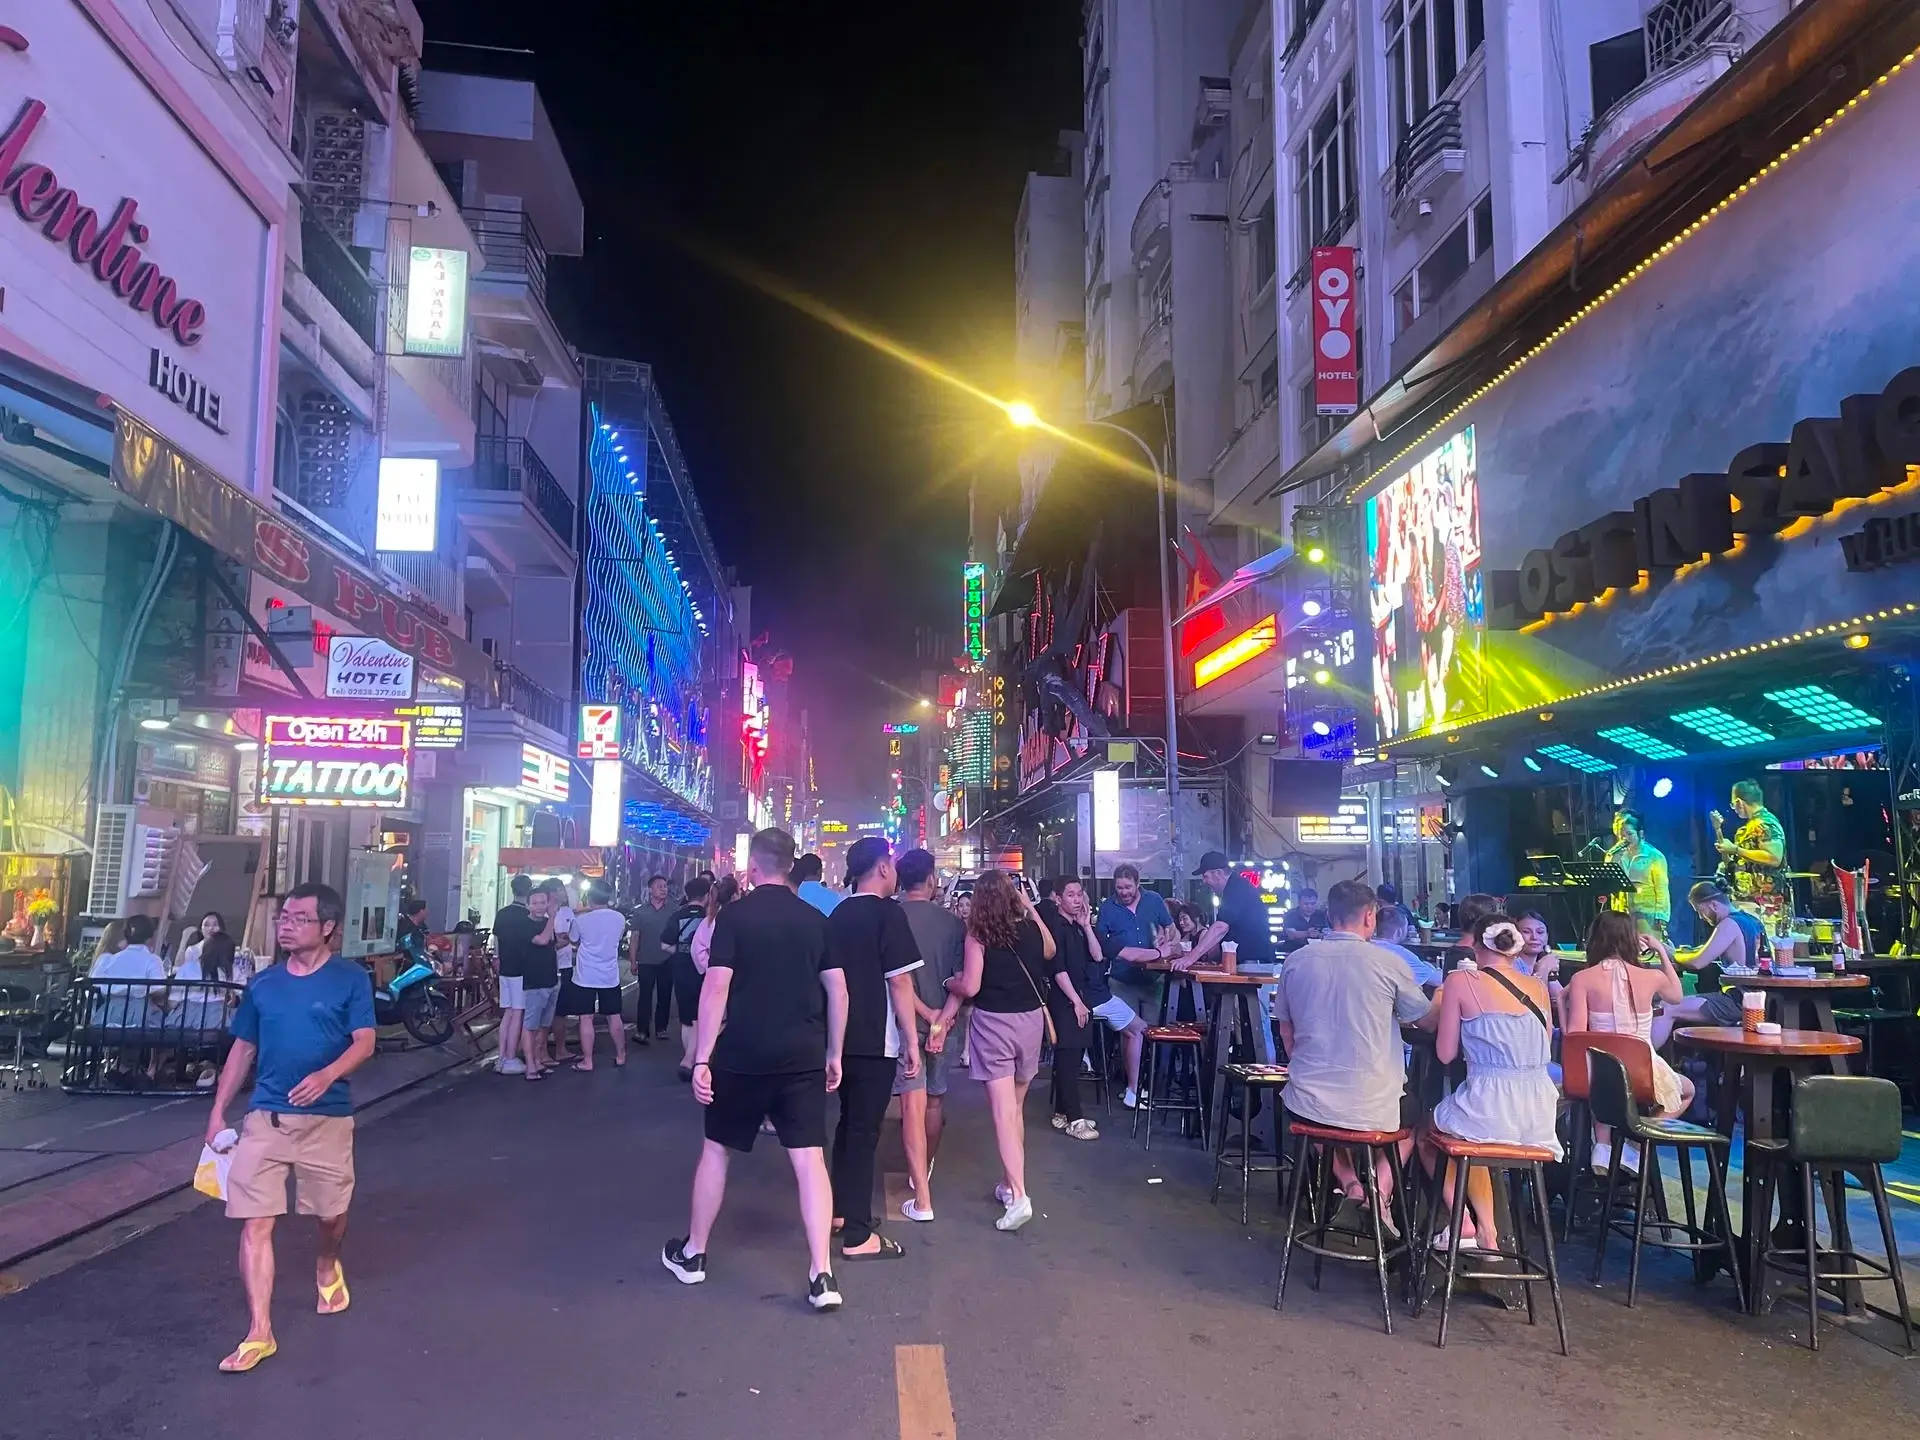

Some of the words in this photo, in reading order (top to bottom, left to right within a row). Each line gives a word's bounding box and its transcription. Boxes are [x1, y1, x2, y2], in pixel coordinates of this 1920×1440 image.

[1318, 267, 1351, 360] OYO
[150, 348, 229, 435] HOTEL
[1318, 371, 1354, 380] HOTEL
[1486, 511, 1636, 630] LOST
[1634, 473, 1733, 566] IN
[333, 565, 455, 667] PUB
[333, 640, 410, 668] Valentine
[337, 672, 404, 685] HOTEL
[288, 720, 344, 746] Open
[349, 722, 387, 742] 24h
[270, 759, 405, 796] TATTOO
